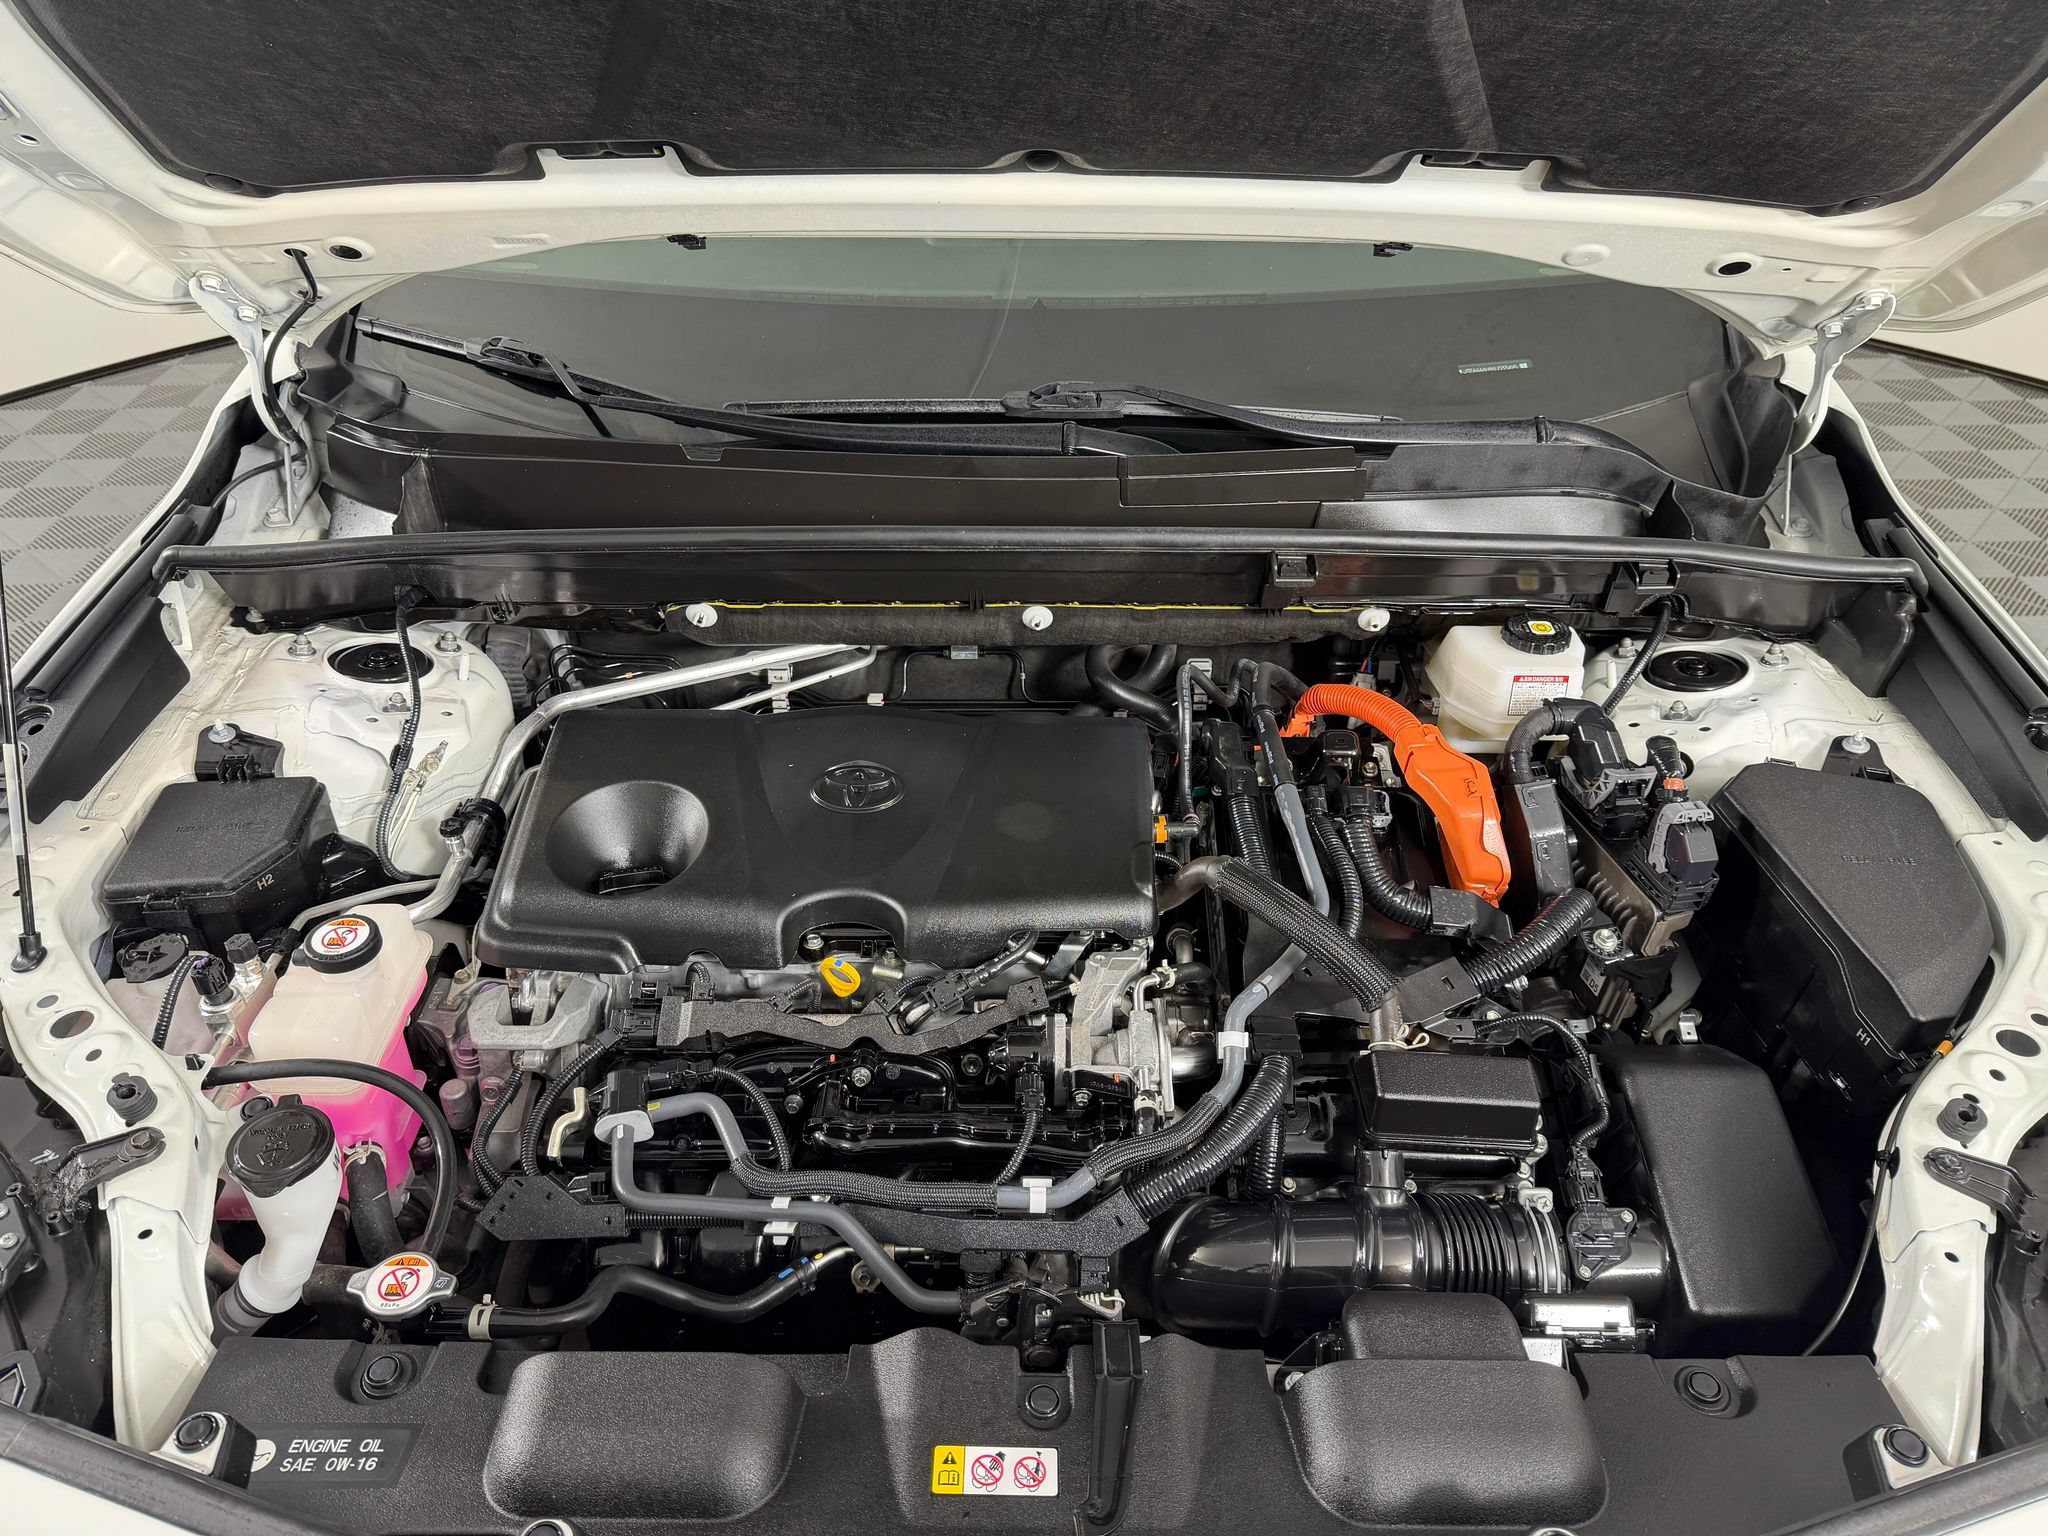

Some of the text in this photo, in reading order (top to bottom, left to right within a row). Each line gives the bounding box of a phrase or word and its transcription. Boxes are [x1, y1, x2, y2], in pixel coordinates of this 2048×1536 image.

[256, 874, 275, 890] H2
[1856, 1028, 1871, 1046] H1
[287, 1438, 384, 1453] ENGINE OIL
[279, 1457, 379, 1472] SAE 0W-16
